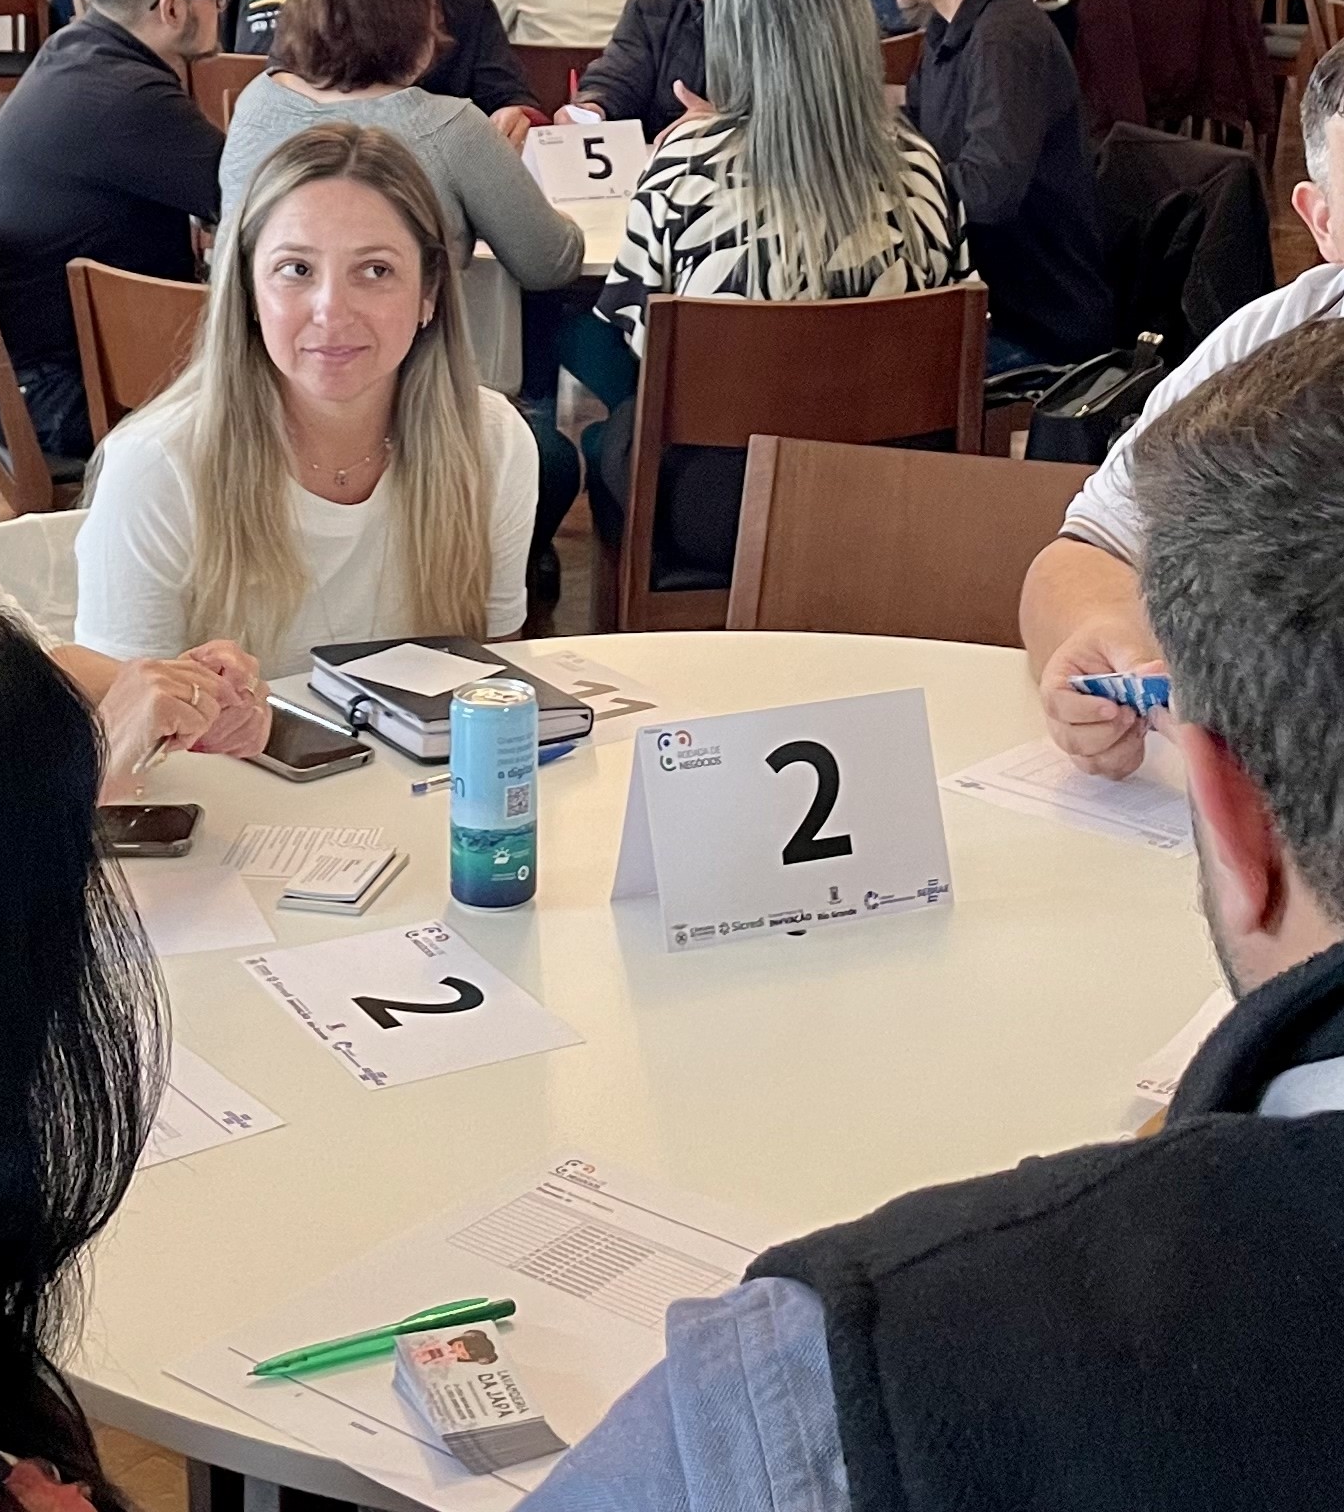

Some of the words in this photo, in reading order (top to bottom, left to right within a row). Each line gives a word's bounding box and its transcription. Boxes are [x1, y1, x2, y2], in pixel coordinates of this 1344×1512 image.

[583, 136, 613, 180] 5
[765, 740, 853, 865] 2
[350, 976, 485, 1030] 2
[477, 1372, 498, 1390] DA
[485, 1390, 515, 1419] JAPA
